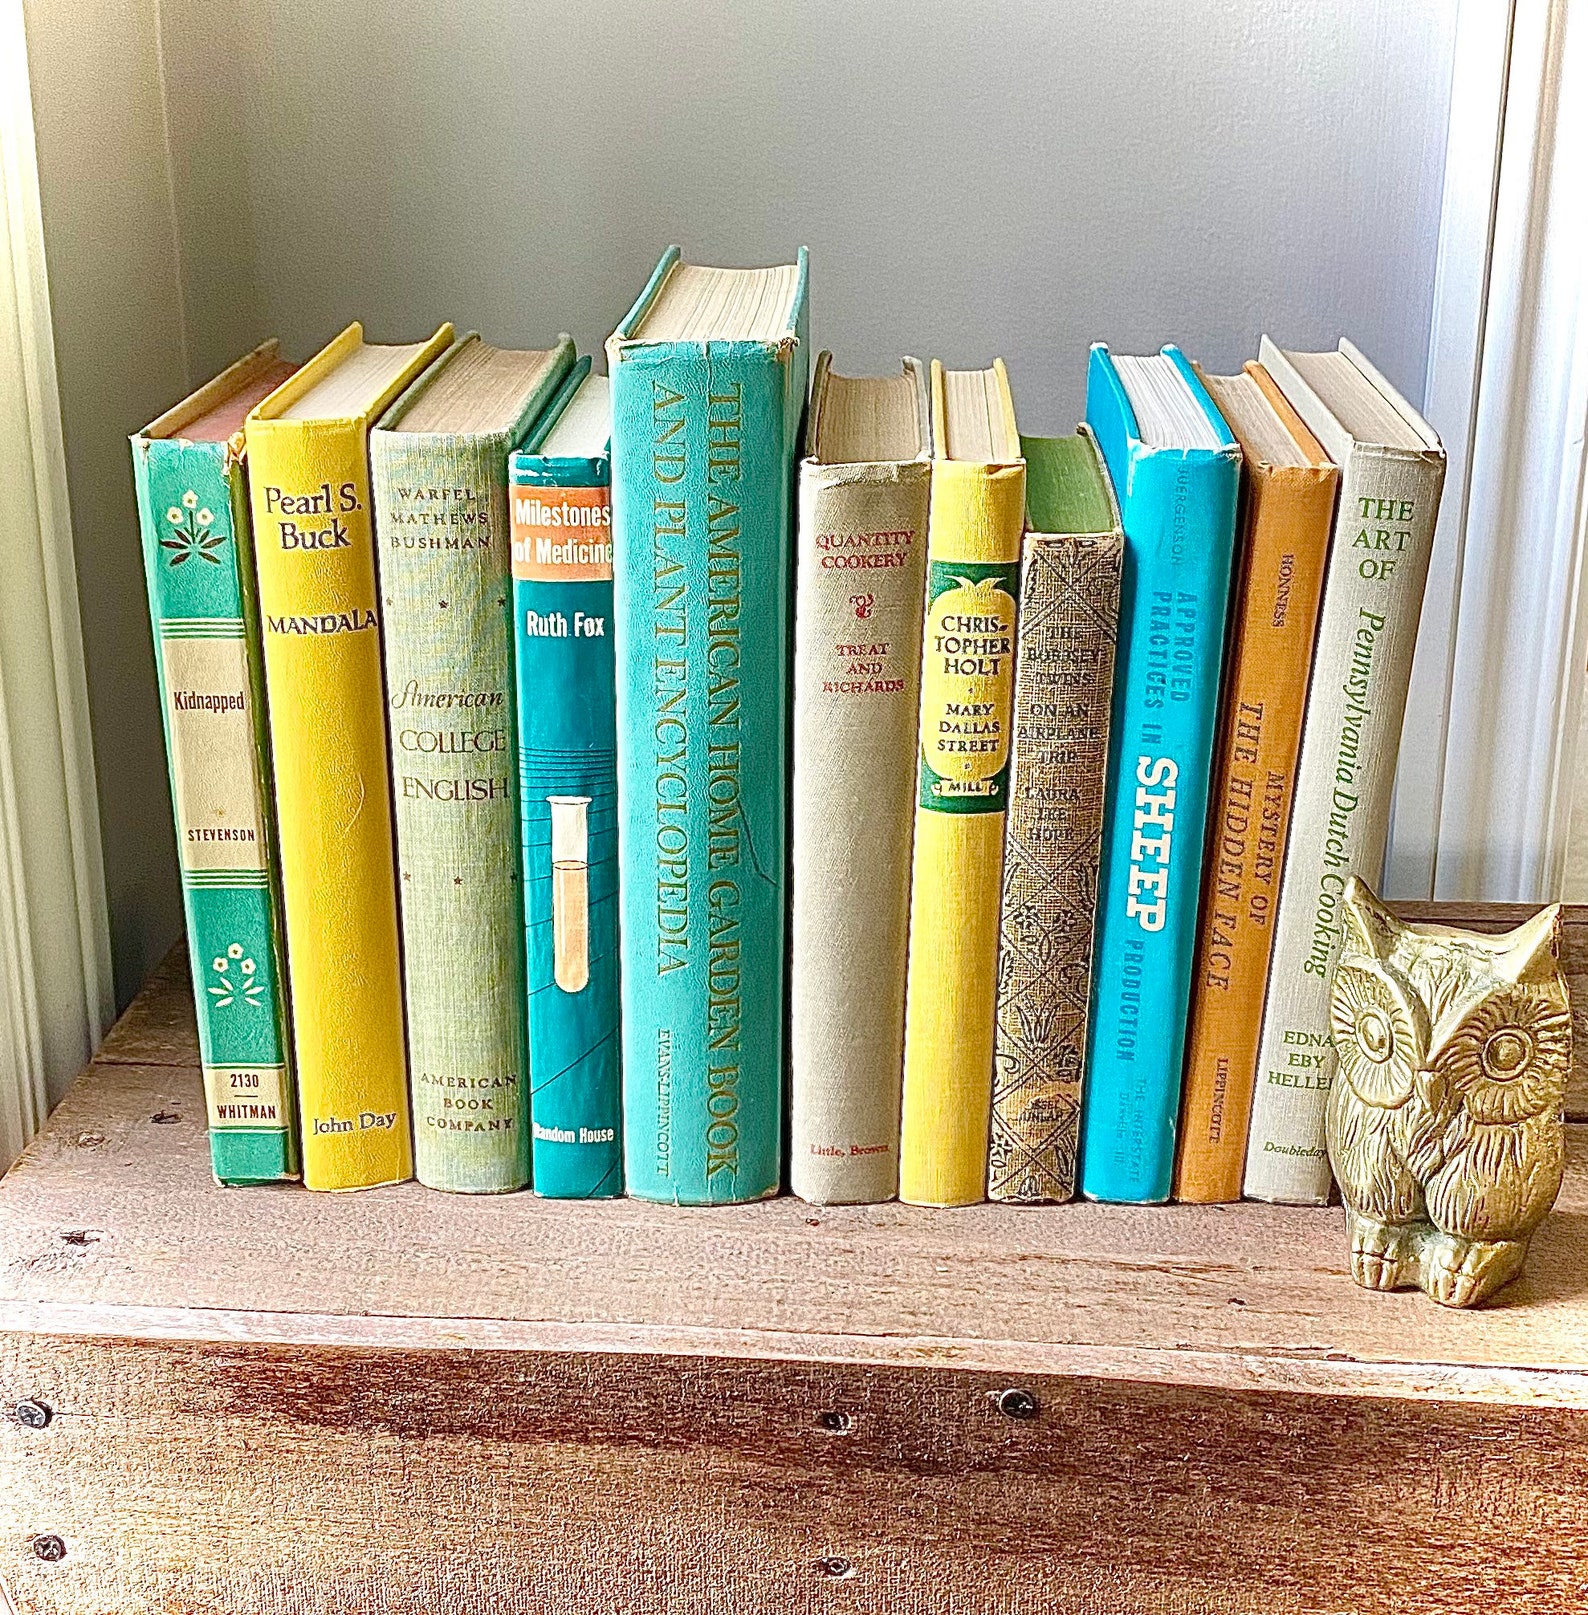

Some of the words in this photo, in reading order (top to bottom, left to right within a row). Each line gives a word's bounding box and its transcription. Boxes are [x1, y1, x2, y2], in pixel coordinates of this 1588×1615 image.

[652, 379, 686, 484] AND
[708, 382, 741, 486] THE
[263, 484, 334, 516] Pearl
[339, 482, 363, 511] S.
[397, 486, 477, 503] WARFEL
[391, 510, 490, 525] MATHEWS
[514, 498, 611, 527] Milestones
[1171, 464, 1192, 567] JUERGENSON
[1358, 497, 1414, 522] THE
[278, 519, 352, 551] Buck
[391, 535, 491, 550] BUSHMAN
[815, 529, 916, 551] QUANTITY
[1352, 528, 1411, 552] ART
[513, 536, 532, 563] of
[535, 537, 613, 565] Medicine
[820, 551, 908, 570] COOKERY
[652, 499, 687, 647] PLANT
[1358, 558, 1396, 580] OF
[1272, 552, 1295, 628] HONNESS
[266, 610, 378, 636] MANDALA
[526, 610, 568, 638] Ruth
[573, 611, 605, 638] Fox
[707, 494, 741, 729] AMERICAN
[835, 643, 891, 658] TREAT
[933, 635, 1012, 656] TOPHER
[1144, 590, 1173, 709] PRACTICES
[1169, 590, 1197, 703] APPROVED
[845, 661, 884, 676] AND
[942, 657, 1002, 677] HOLT
[391, 679, 504, 710] American
[821, 678, 906, 695] RICHARDS
[1336, 607, 1386, 788] Pennsylvania
[173, 690, 246, 713] Kidnapped
[945, 702, 996, 716] MARY
[938, 719, 1001, 735] DALLAS
[1140, 723, 1163, 745] IN
[1234, 701, 1263, 765] THE
[399, 728, 506, 754] COLLEGE
[936, 738, 1001, 753] STREET
[402, 776, 508, 802] ENGLISH
[947, 781, 984, 793] MILL
[654, 656, 690, 976] ENCYCLOPEDIA
[707, 741, 741, 872] HOME
[187, 828, 256, 843] STEVENSON
[1216, 777, 1252, 903] HIDDEN
[1256, 771, 1285, 885] MYSTERY
[1324, 787, 1359, 872] Dutch
[1126, 755, 1180, 932] SHEEP
[1250, 895, 1269, 926] OF
[1304, 871, 1344, 978] Cooking
[1206, 912, 1236, 992] FACE
[707, 879, 741, 1052] GARDEN
[1115, 939, 1144, 1062] PRODUCTION
[1283, 1030, 1335, 1047] EDNA
[1287, 1053, 1326, 1069] EBY
[229, 1073, 260, 1090] 2130
[420, 1072, 517, 1088] AMERICAN
[216, 1103, 277, 1120] WHITMAN
[443, 1098, 494, 1111] BOOK
[1208, 1057, 1229, 1145] LIPPINCOTT
[313, 1115, 354, 1136] John
[358, 1110, 398, 1131] Day
[427, 1115, 514, 1132] COMPANY
[705, 1063, 741, 1177] BOOK
[579, 1126, 615, 1144] House
[848, 1143, 890, 1157] Brown
[1263, 1141, 1328, 1160] Doubleday
